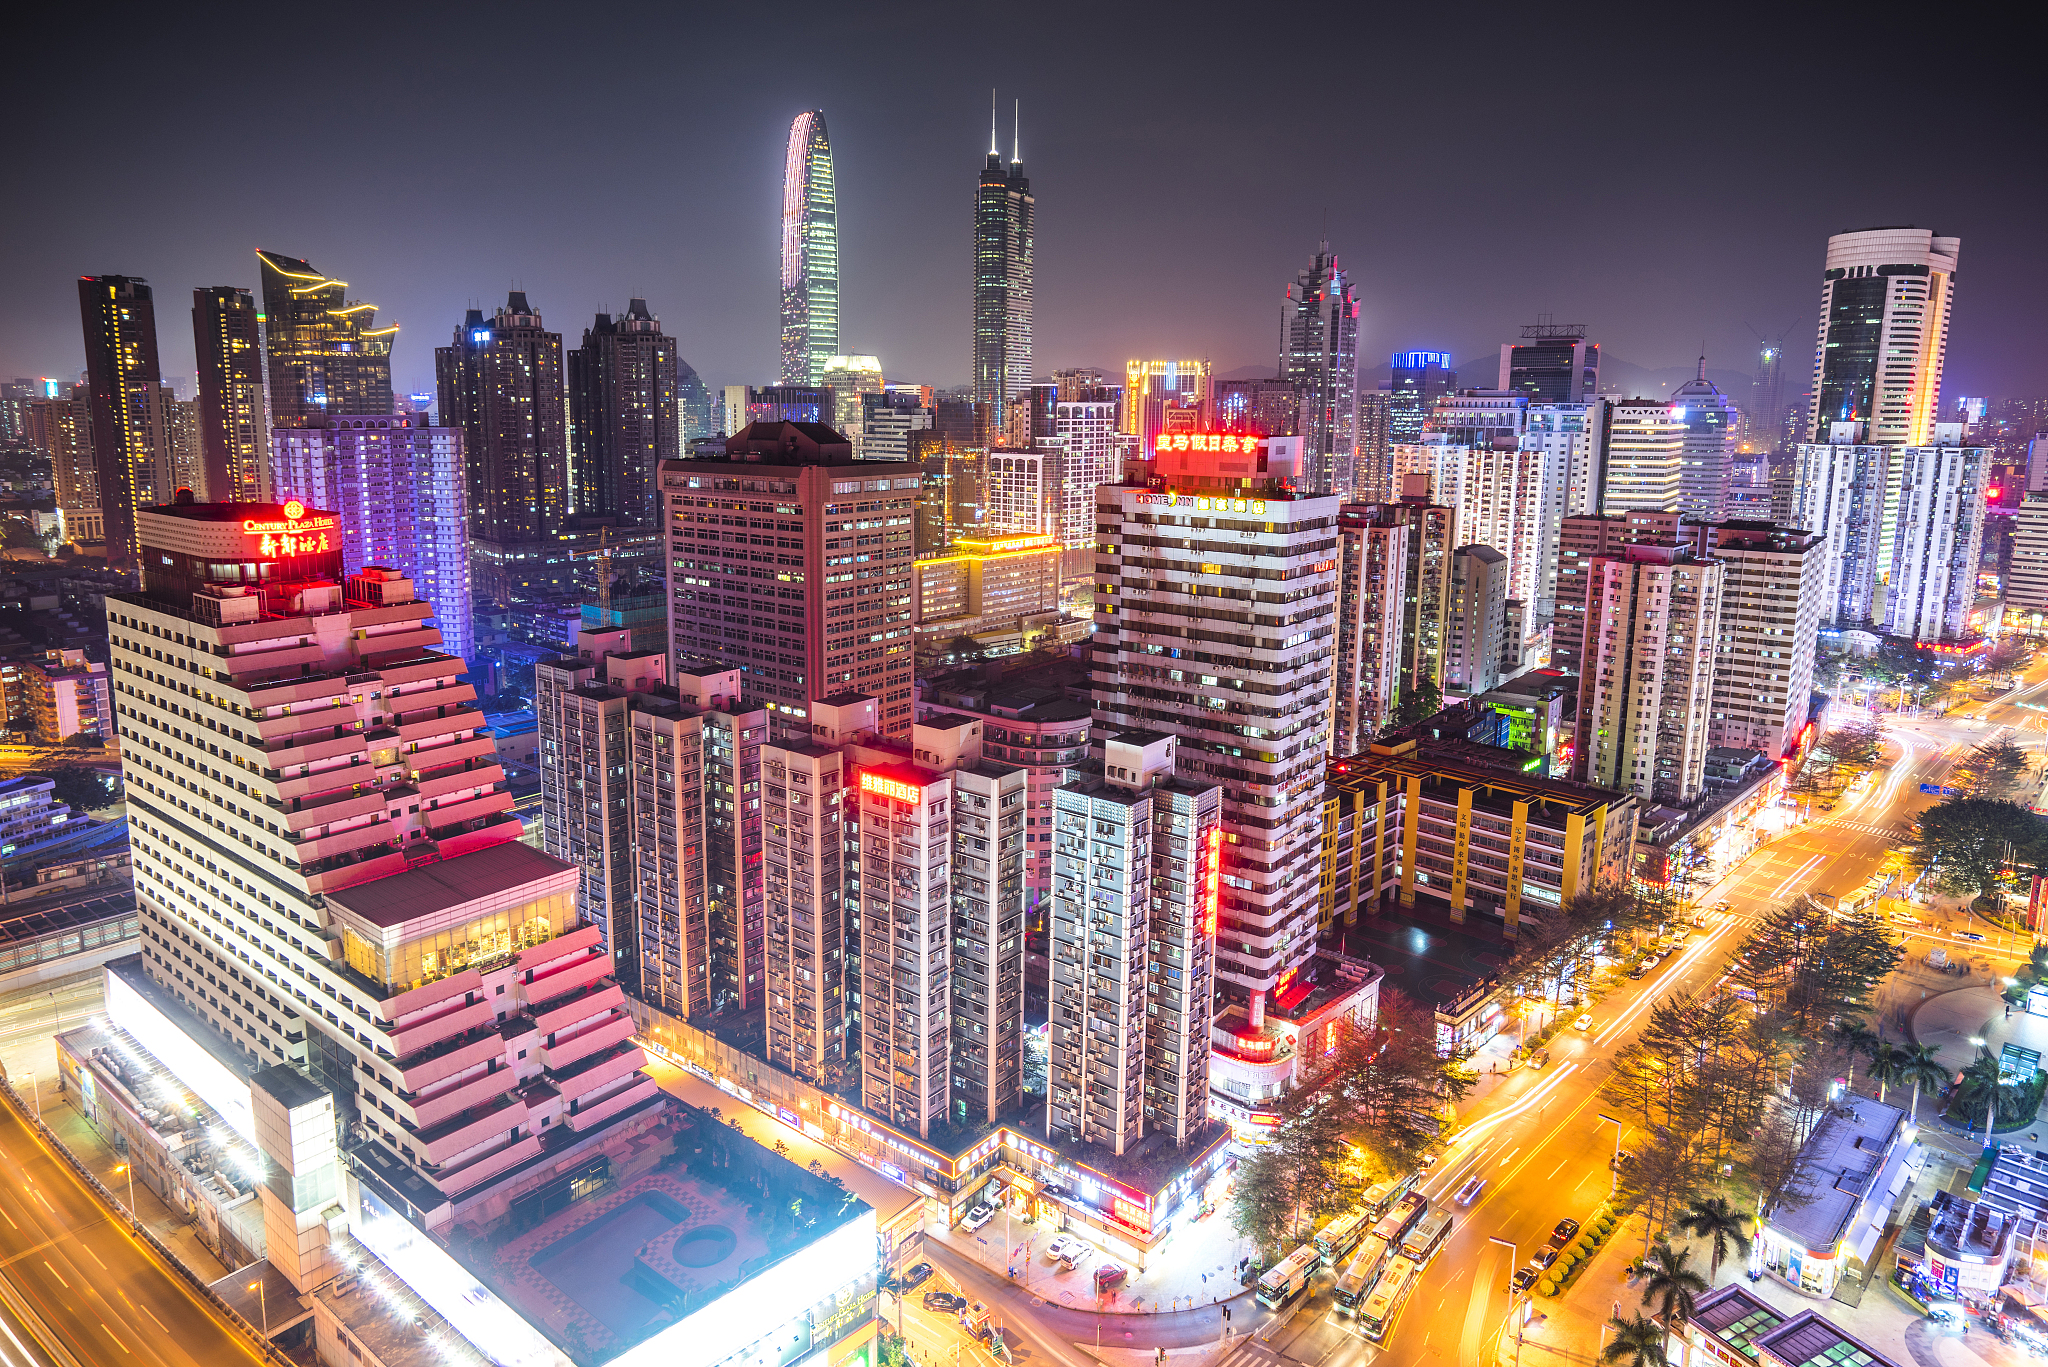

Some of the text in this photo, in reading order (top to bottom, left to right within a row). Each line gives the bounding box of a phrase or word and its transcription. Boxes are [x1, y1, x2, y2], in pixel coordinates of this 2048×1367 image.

[1156, 434, 1258, 453] 皇马假日桑拿
[1136, 495, 1168, 505] HOME
[1198, 497, 1265, 515] 如家酒店
[244, 517, 334, 531] CENTURY PLAZA HOTEL
[260, 532, 329, 558] 新都酒店
[862, 773, 919, 803] 维雅丽酒店
